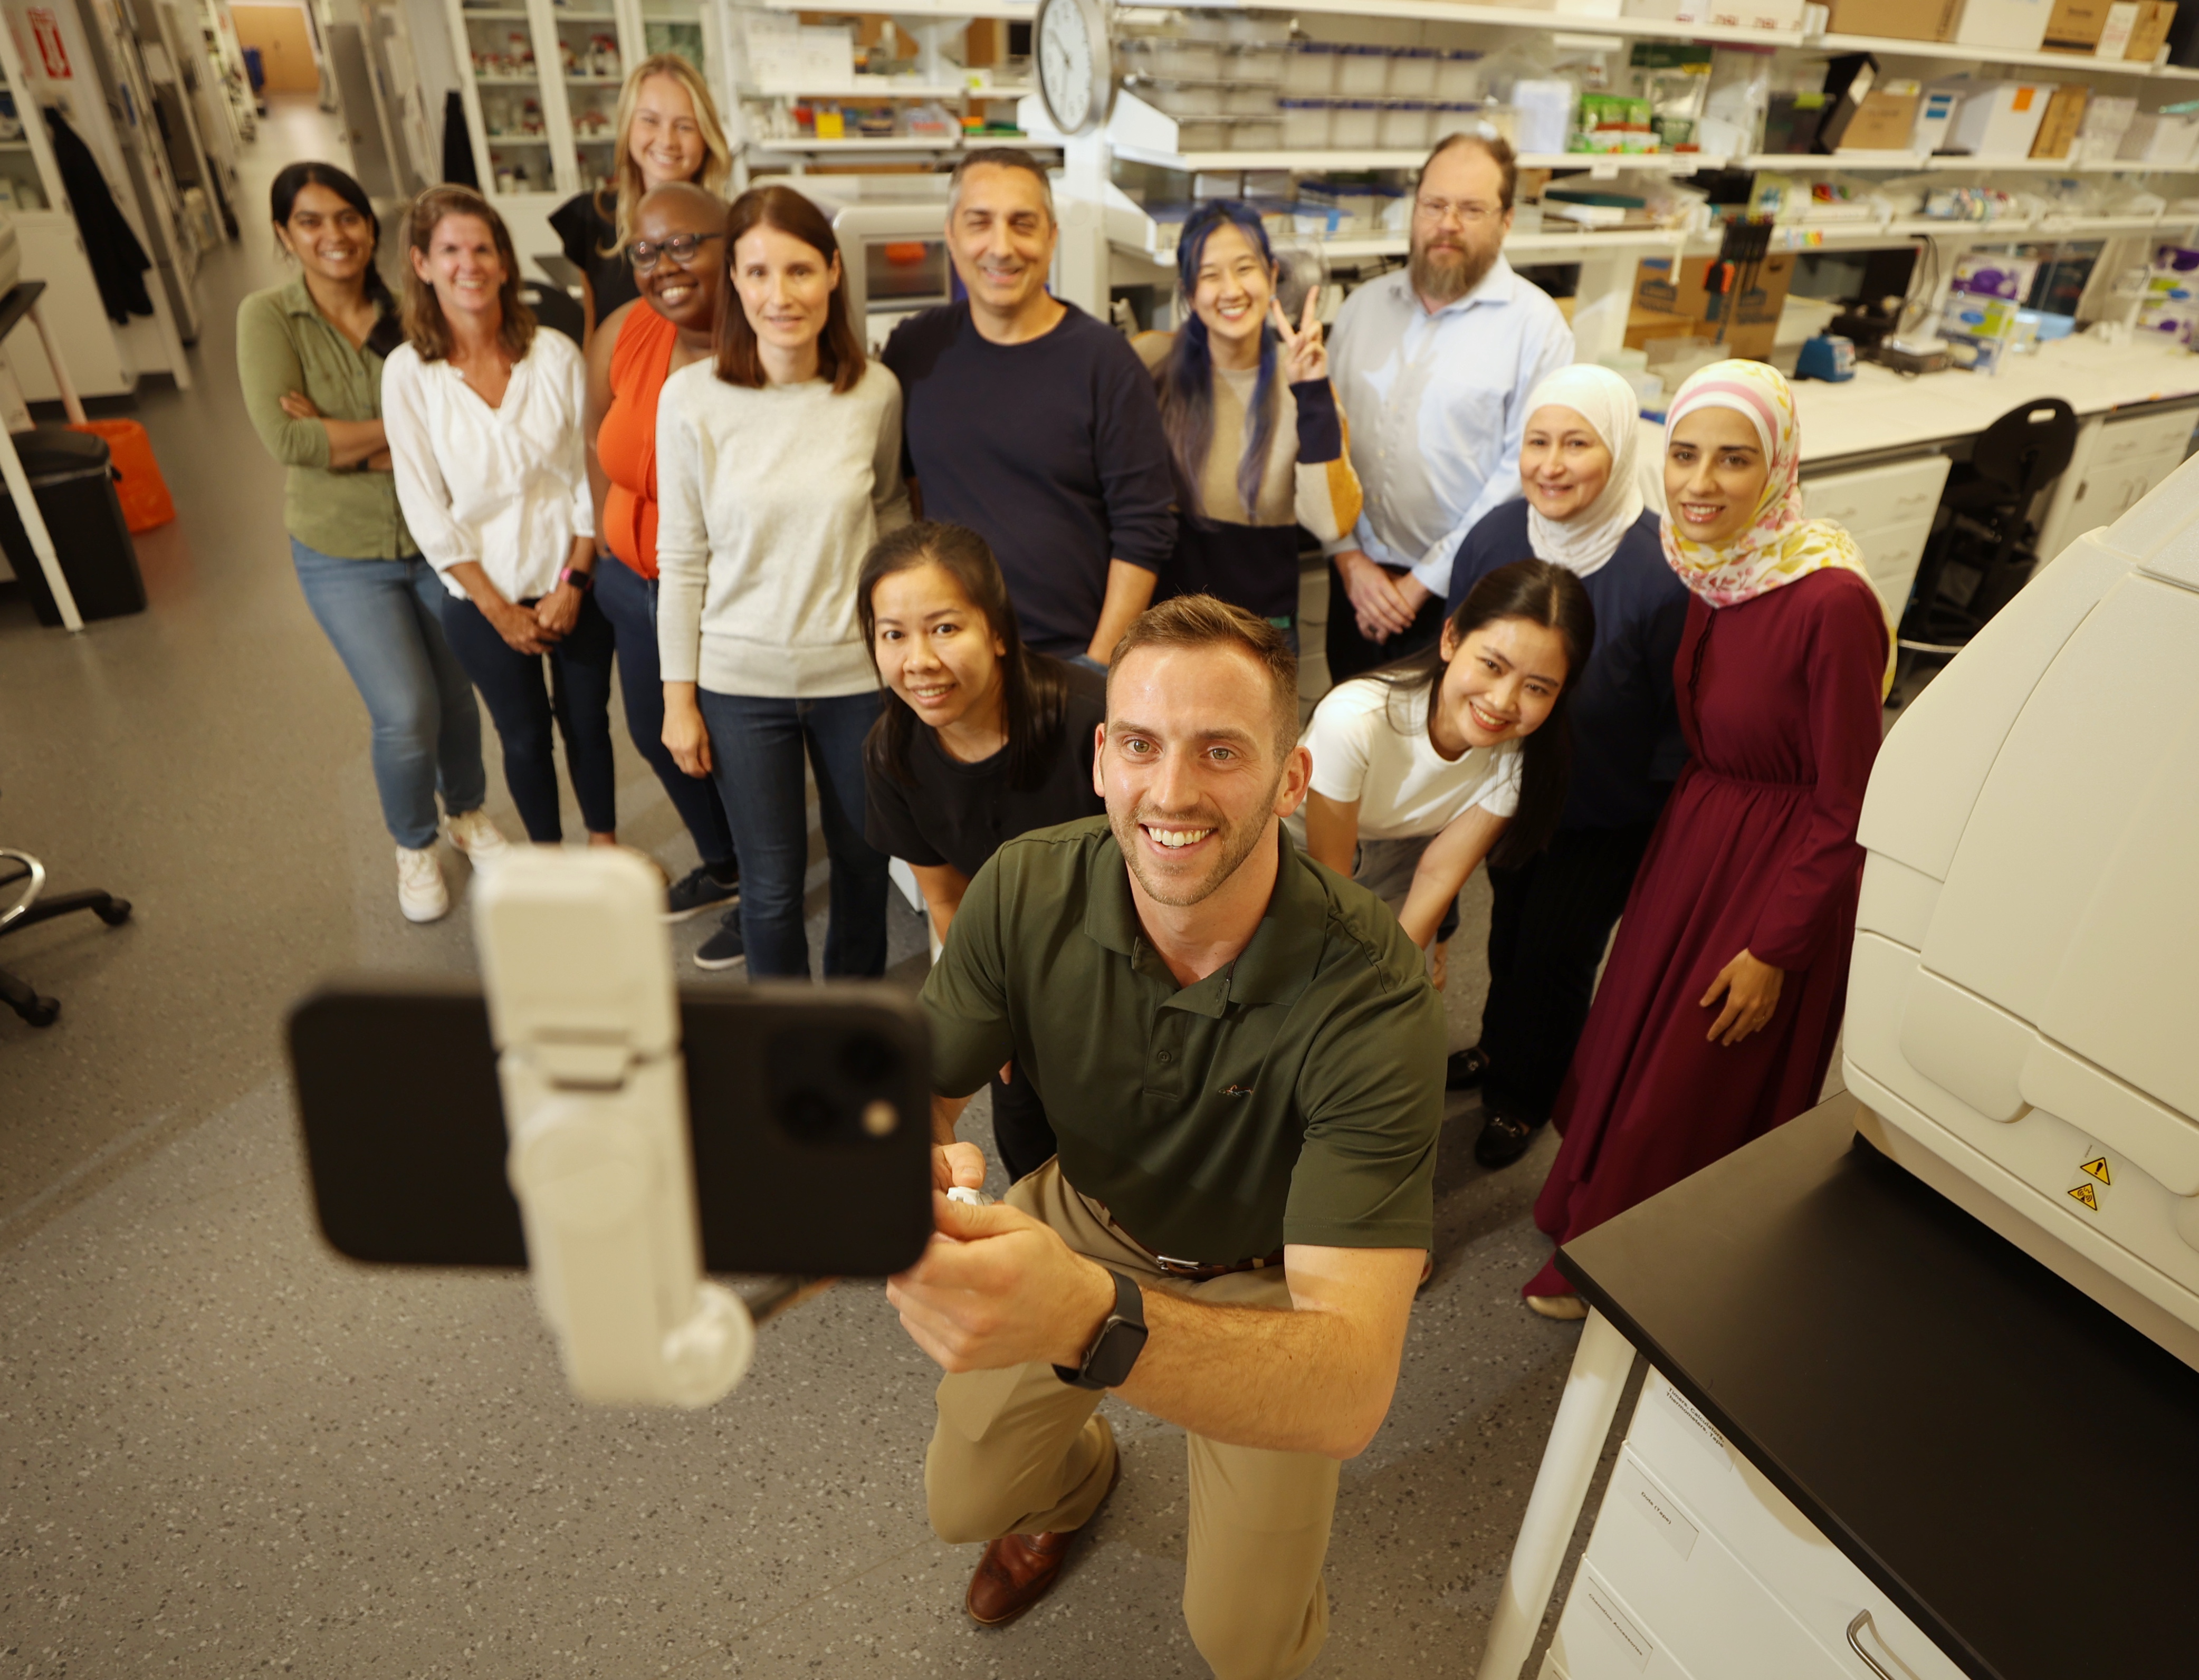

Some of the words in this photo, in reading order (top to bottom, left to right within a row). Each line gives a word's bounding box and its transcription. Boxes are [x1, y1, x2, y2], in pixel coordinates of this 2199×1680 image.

[1667, 1391, 1708, 1434] Thermometers,
[1710, 1432, 1724, 1448] Tape
[1669, 1387, 1689, 1409] Timers,
[1690, 1408, 1724, 1443] Calculators,
[1641, 1492, 1653, 1505] Dots
[1654, 1505, 1671, 1525] (Tape)
